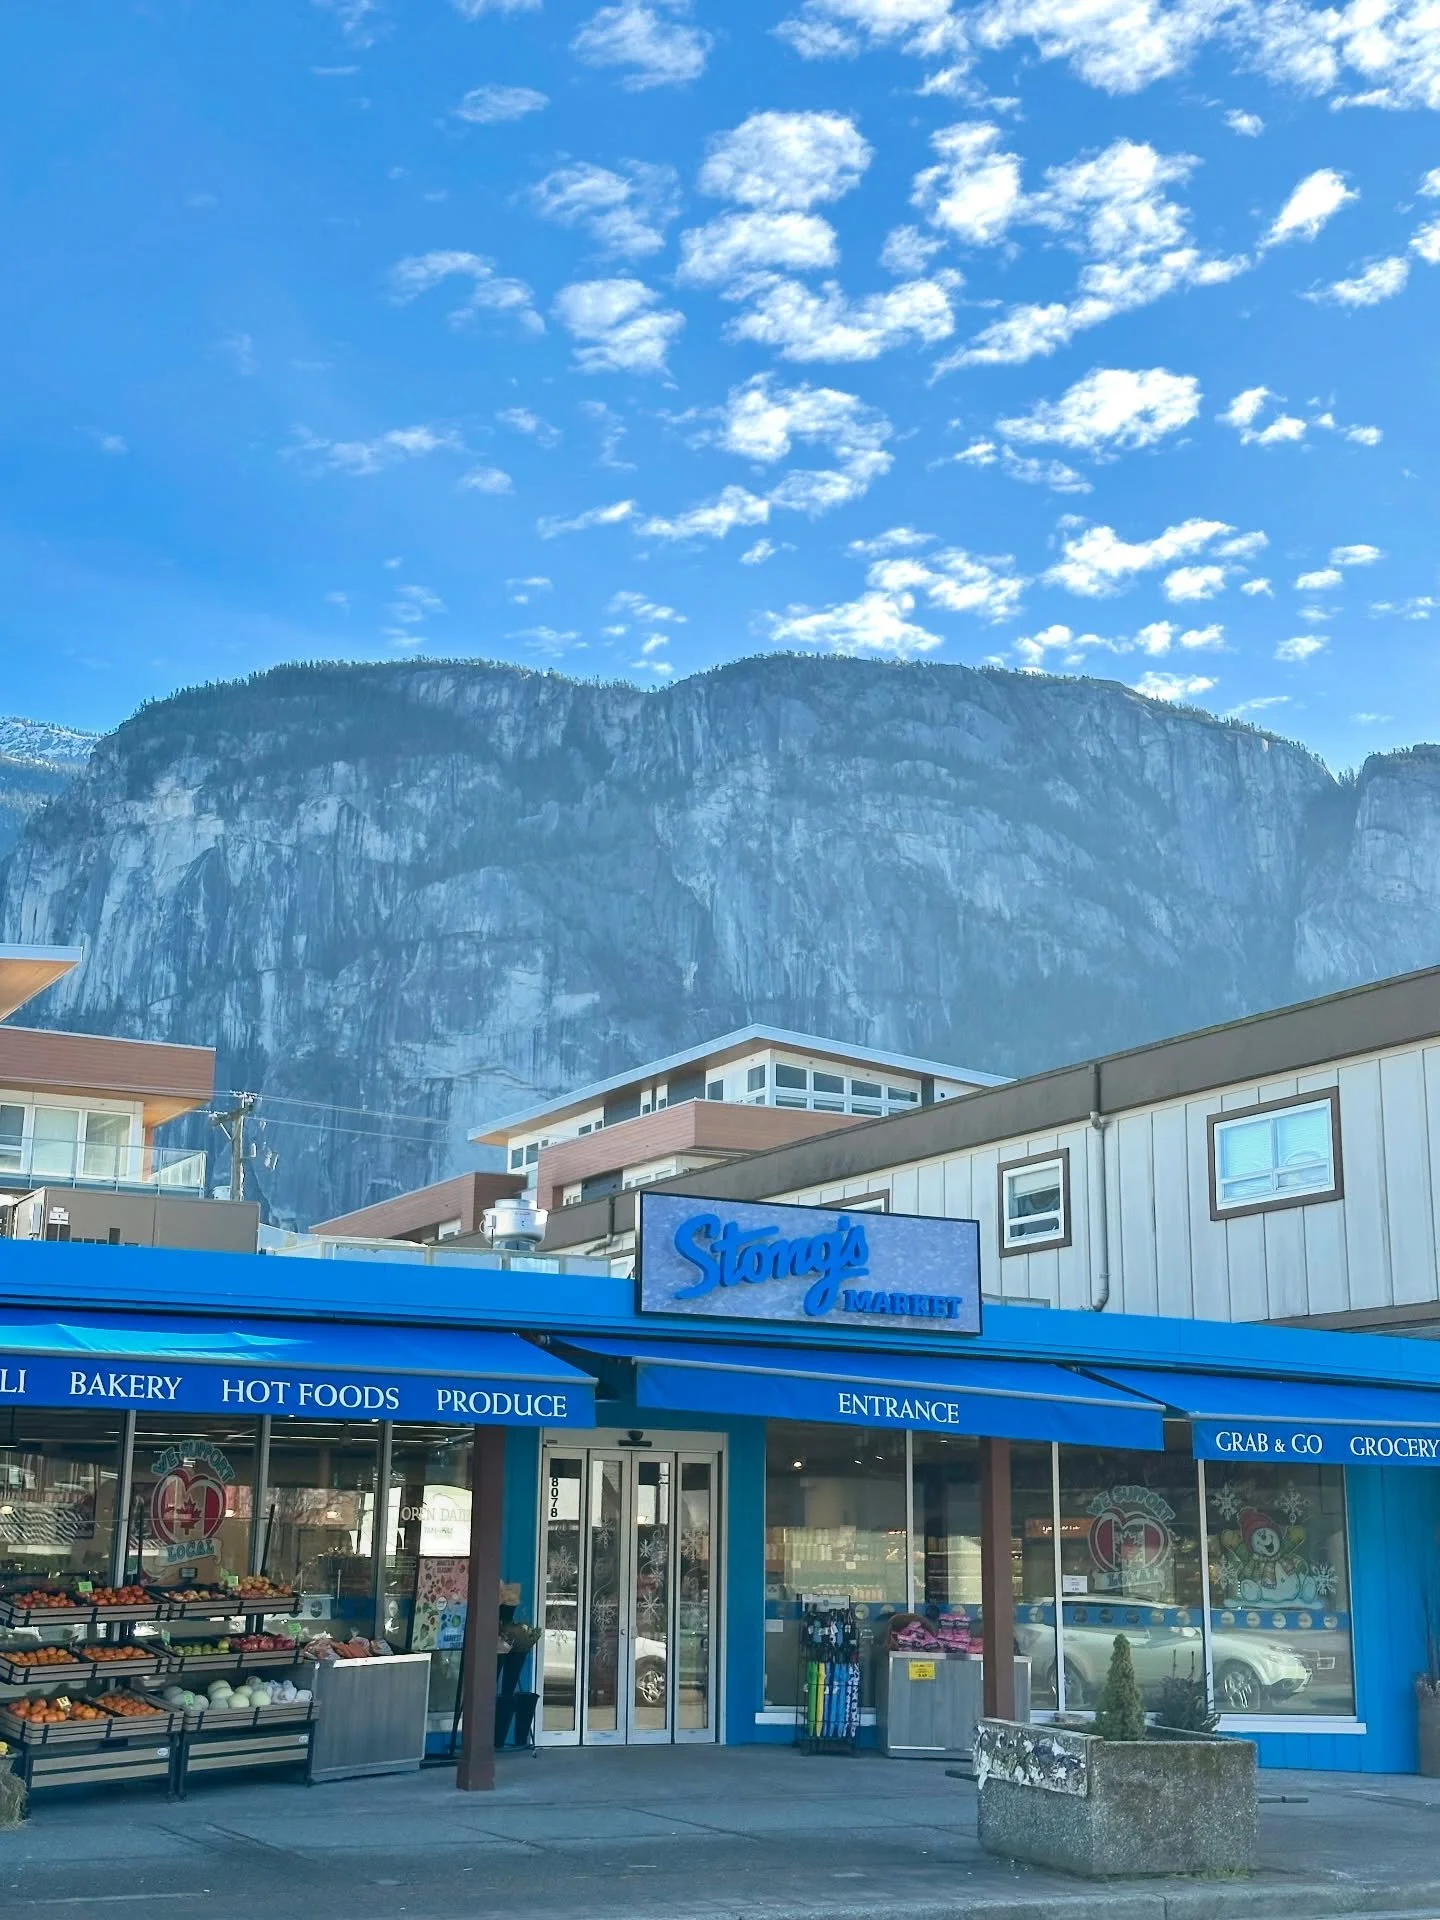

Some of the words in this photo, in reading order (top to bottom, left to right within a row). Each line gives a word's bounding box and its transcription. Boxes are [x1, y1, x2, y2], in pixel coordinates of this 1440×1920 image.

[674, 1213, 869, 1317] Stong's
[843, 1289, 963, 1320] MARKET
[70, 1371, 182, 1400] BAKERY
[222, 1379, 291, 1404] HOT
[299, 1383, 399, 1410] FOODS
[437, 1389, 567, 1417] PRODUCE
[838, 1393, 959, 1424] ENTRANCE
[152, 1447, 179, 1475] WE
[179, 1440, 235, 1483] SUPPORT
[1215, 1432, 1269, 1453] GRAB
[1274, 1438, 1286, 1453] &
[1291, 1433, 1323, 1454] GO
[1350, 1436, 1440, 1457] GROCERY
[550, 1477, 559, 1518] 8078
[1087, 1491, 1112, 1515] WE
[1112, 1485, 1176, 1522] SUPPORT
[166, 1540, 214, 1562] LOCAL
